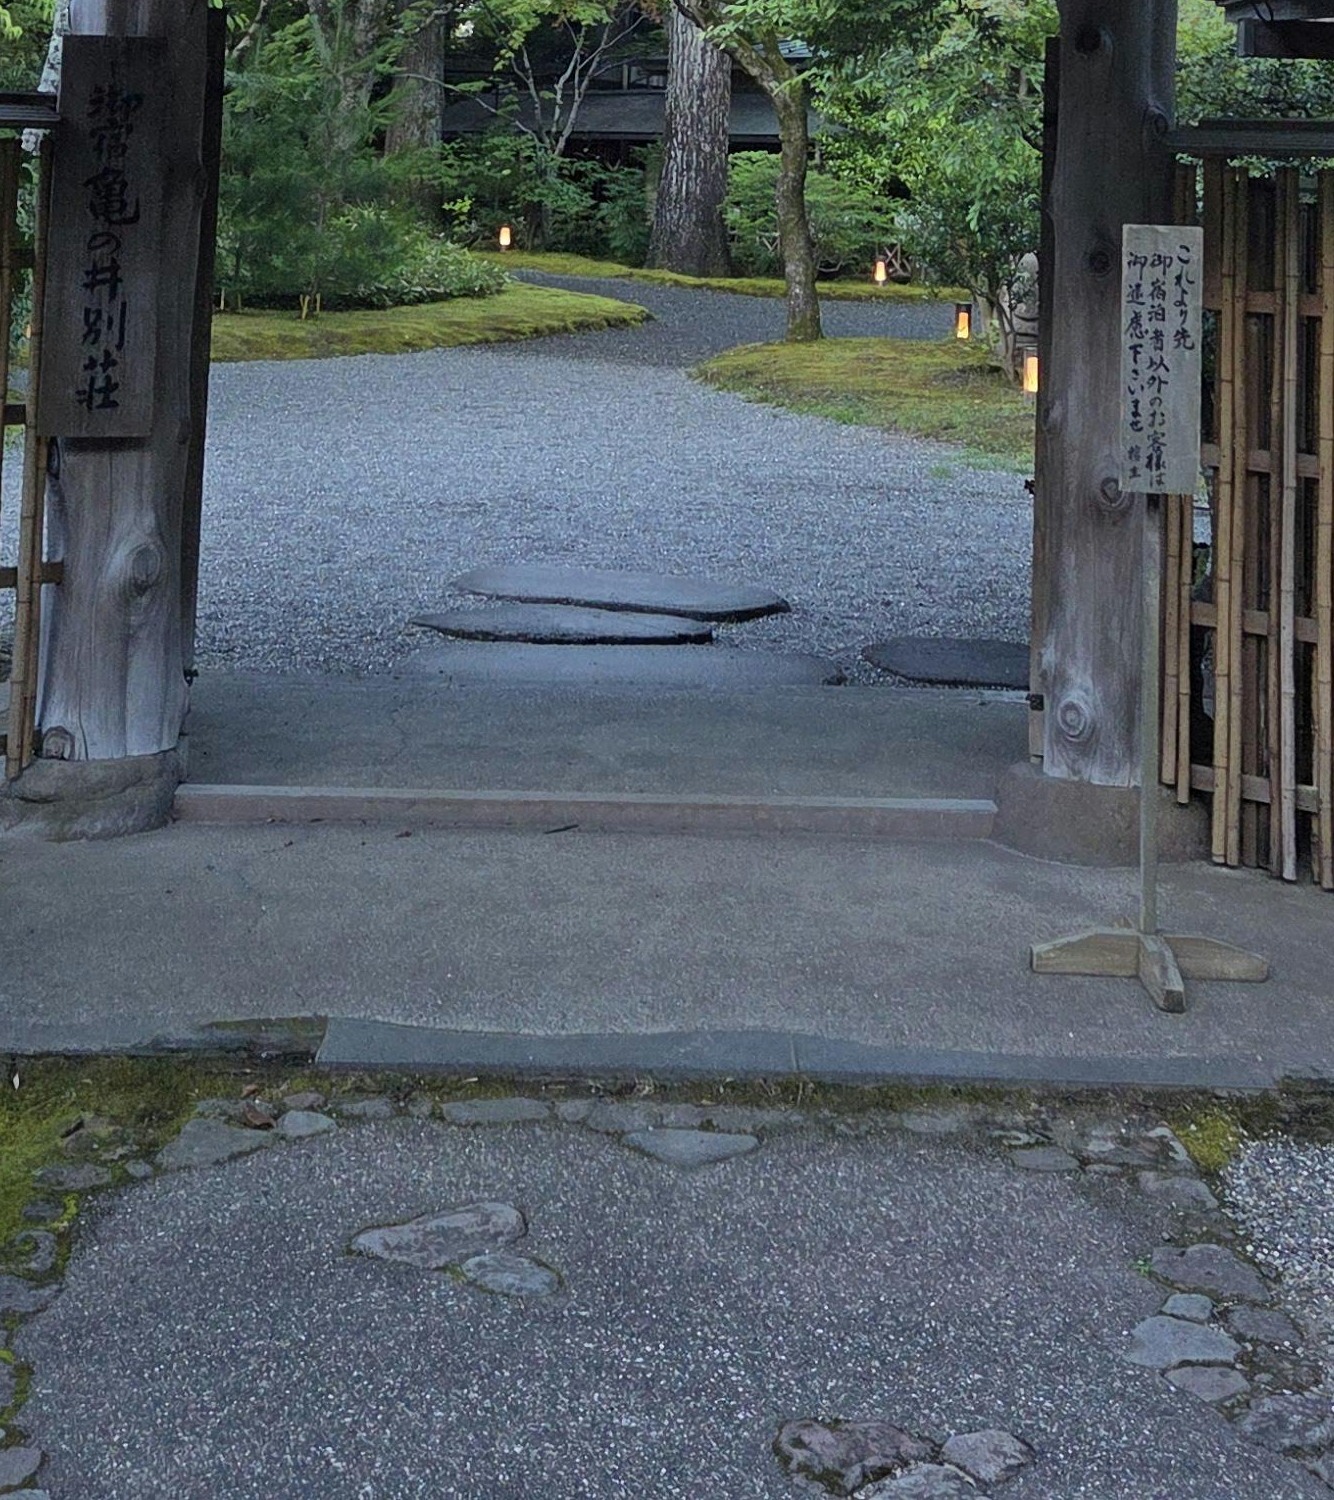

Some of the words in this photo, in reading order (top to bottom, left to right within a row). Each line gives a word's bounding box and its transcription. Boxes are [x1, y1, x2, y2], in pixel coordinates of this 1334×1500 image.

[1144, 252, 1173, 488] 御宿泊者以外のお客様は
[1172, 244, 1195, 351] これより先
